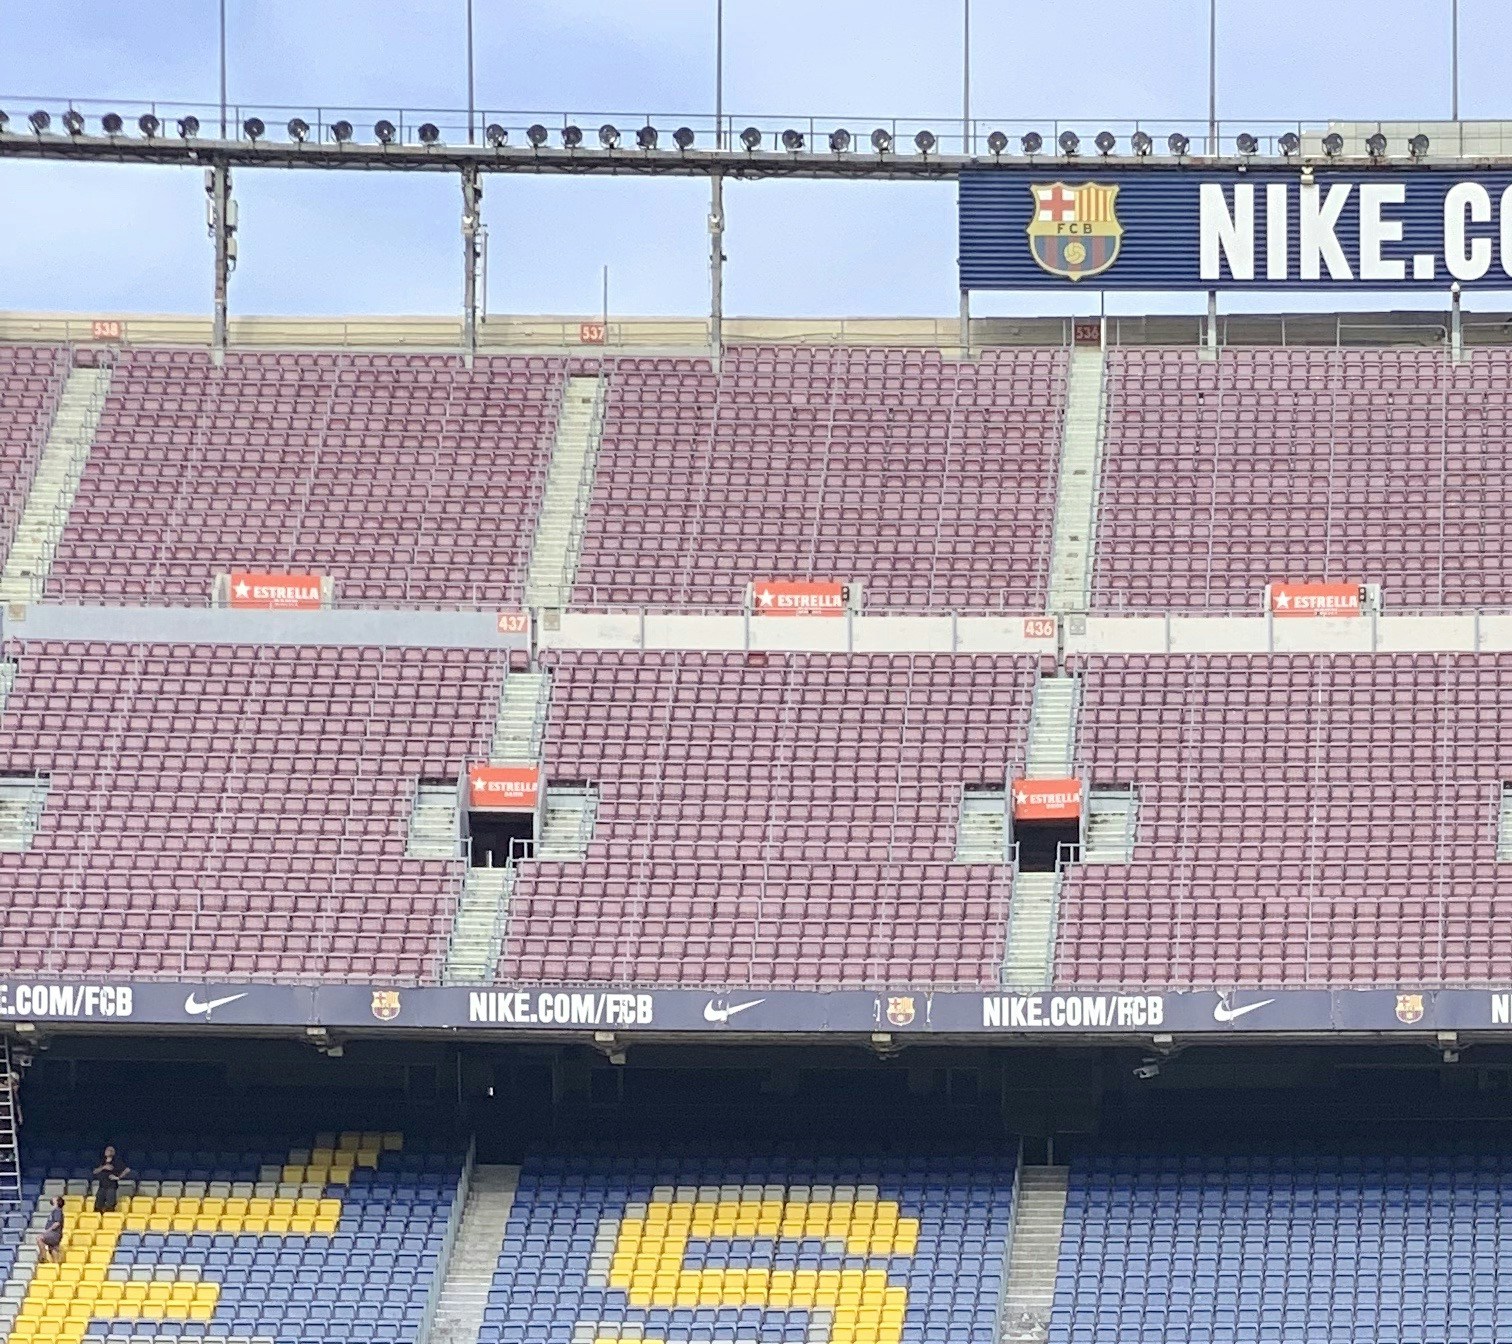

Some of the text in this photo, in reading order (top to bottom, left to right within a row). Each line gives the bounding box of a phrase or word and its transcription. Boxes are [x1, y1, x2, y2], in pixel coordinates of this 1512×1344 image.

[94, 322, 118, 336] 538
[582, 326, 605, 340] 537
[1076, 326, 1099, 339] 536
[253, 586, 319, 600] ESTRELLA
[777, 594, 842, 607] ESTRELLA
[1294, 595, 1358, 608] ESTRELLA
[499, 616, 526, 631] 437
[1025, 621, 1053, 636] 436
[488, 781, 538, 792] ESTRELLA
[1029, 793, 1080, 804] ESTRELLA
[469, 992, 653, 1023] NIKE.COM/FCB
